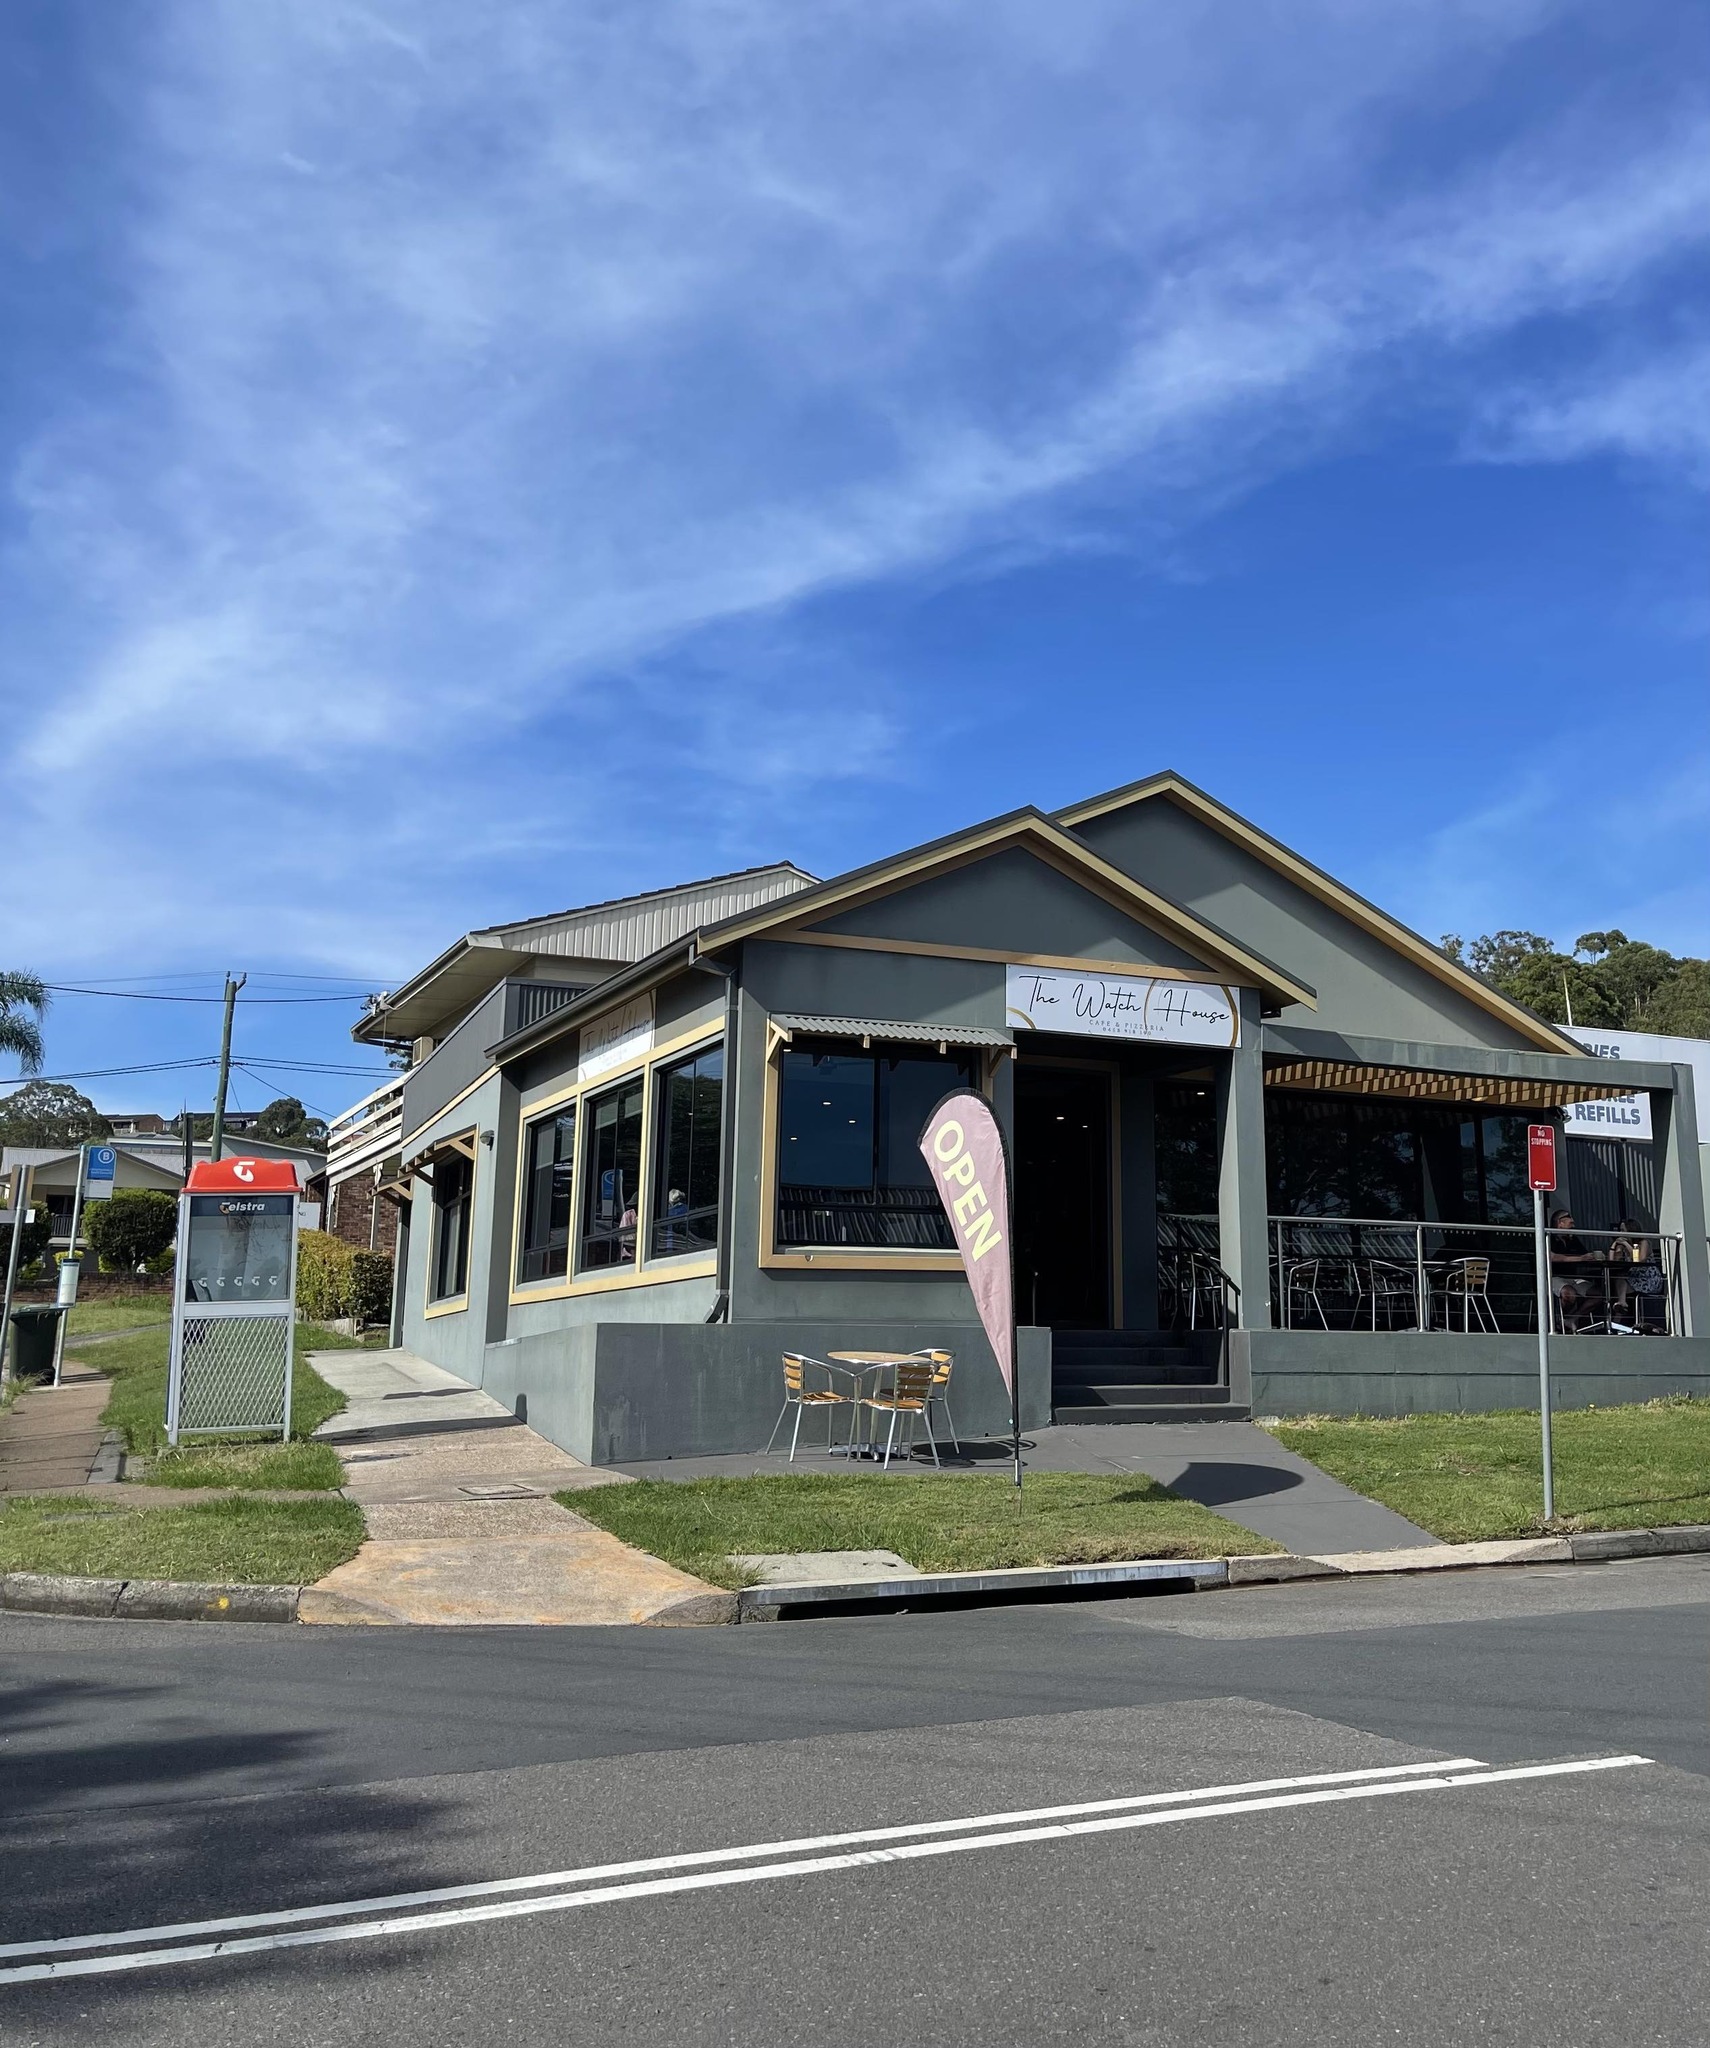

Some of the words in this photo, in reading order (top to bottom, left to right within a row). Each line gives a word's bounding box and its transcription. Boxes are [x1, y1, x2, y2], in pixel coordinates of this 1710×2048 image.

[1019, 975, 1060, 1012] The
[1072, 981, 1142, 1019] Watch
[1153, 989, 1230, 1026] House
[1575, 1103, 1641, 1125] REFILLS
[1530, 1137, 1552, 1147] STOPPING
[1537, 1129, 1546, 1137] NO
[934, 1119, 1003, 1263] OPEN
